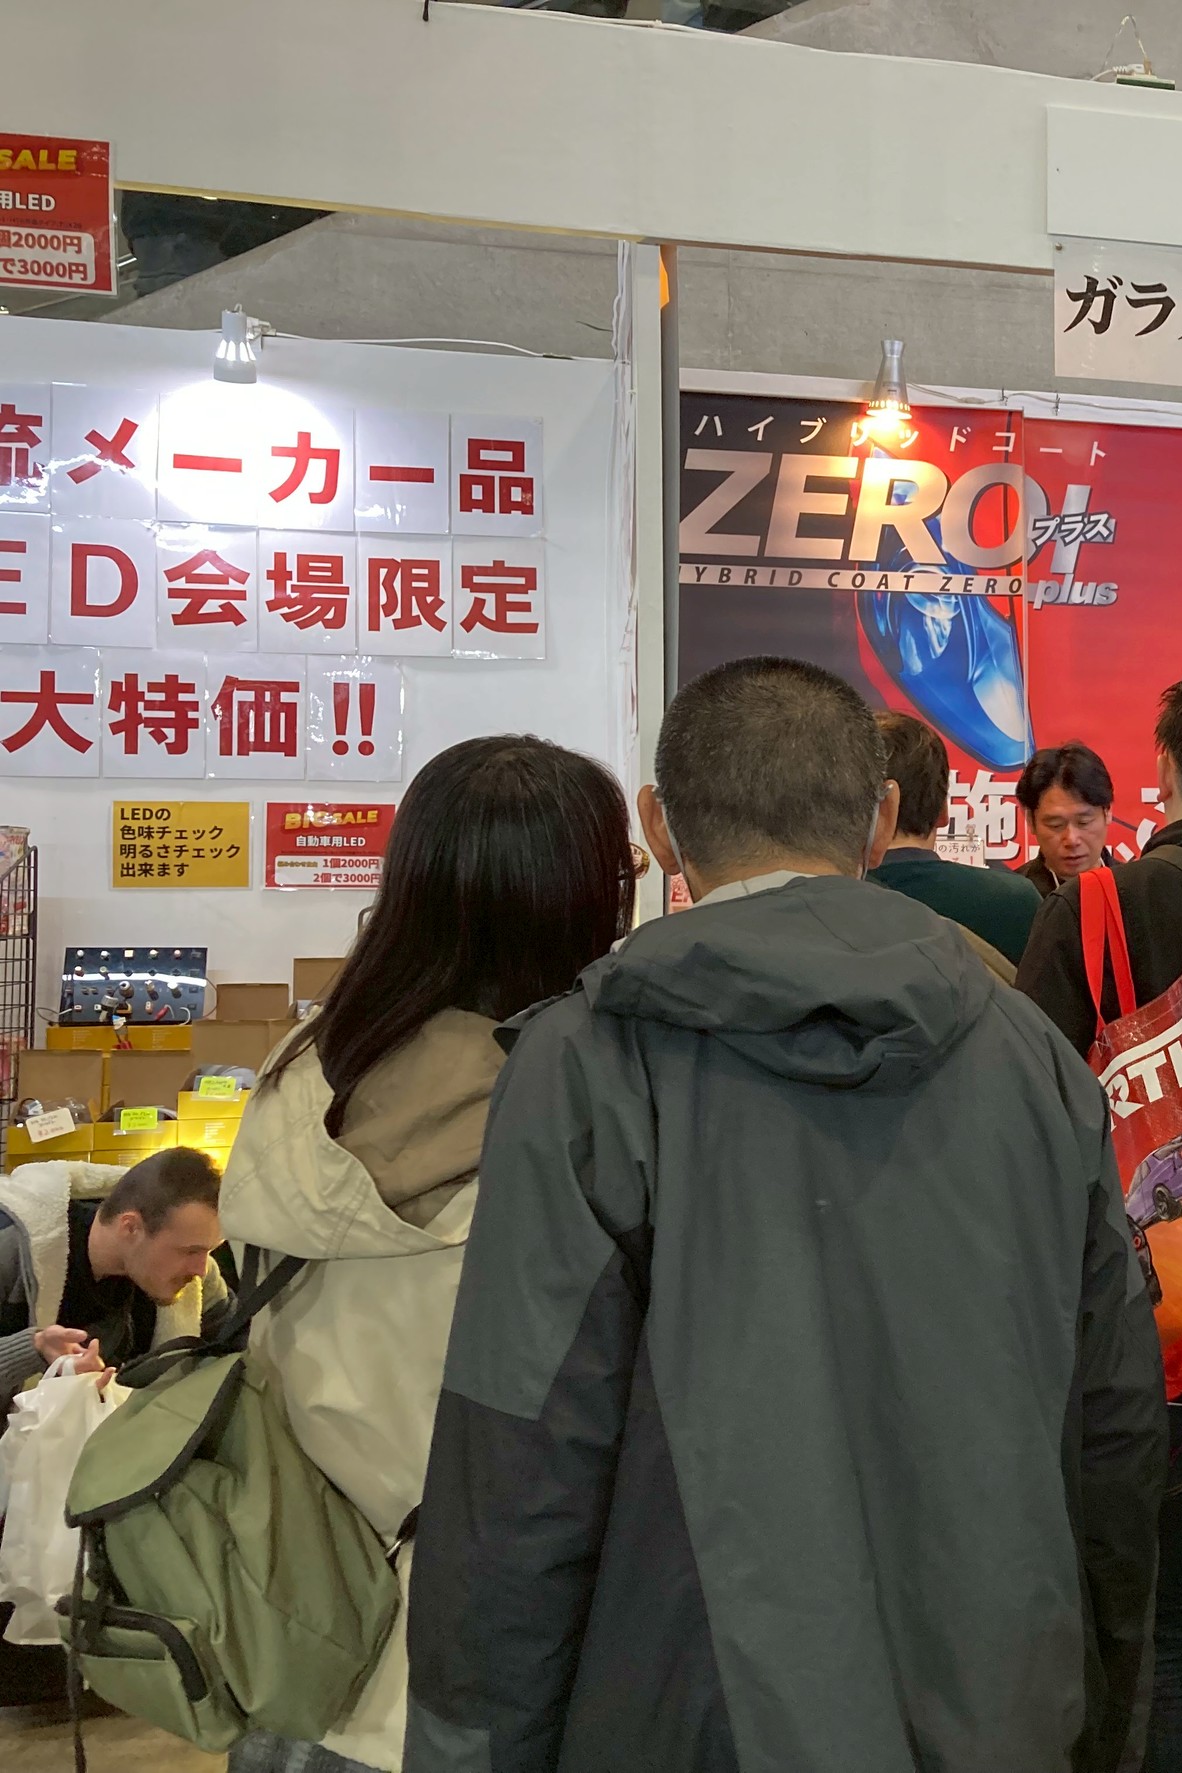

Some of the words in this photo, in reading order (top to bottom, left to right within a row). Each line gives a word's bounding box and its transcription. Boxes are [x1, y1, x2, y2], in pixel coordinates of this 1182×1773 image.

[679, 447, 1050, 568] ZERO
[1033, 512, 1114, 548] プラス
[827, 571, 915, 591] COAT
[938, 577, 1022, 595] ZERO
[1033, 572, 1119, 610] plus
[120, 808, 171, 821] LEDの
[120, 825, 223, 840] 色味チェック
[296, 836, 366, 847] 自動車用LED
[120, 844, 240, 859] 明るさチェック
[120, 862, 189, 877] 出来ます
